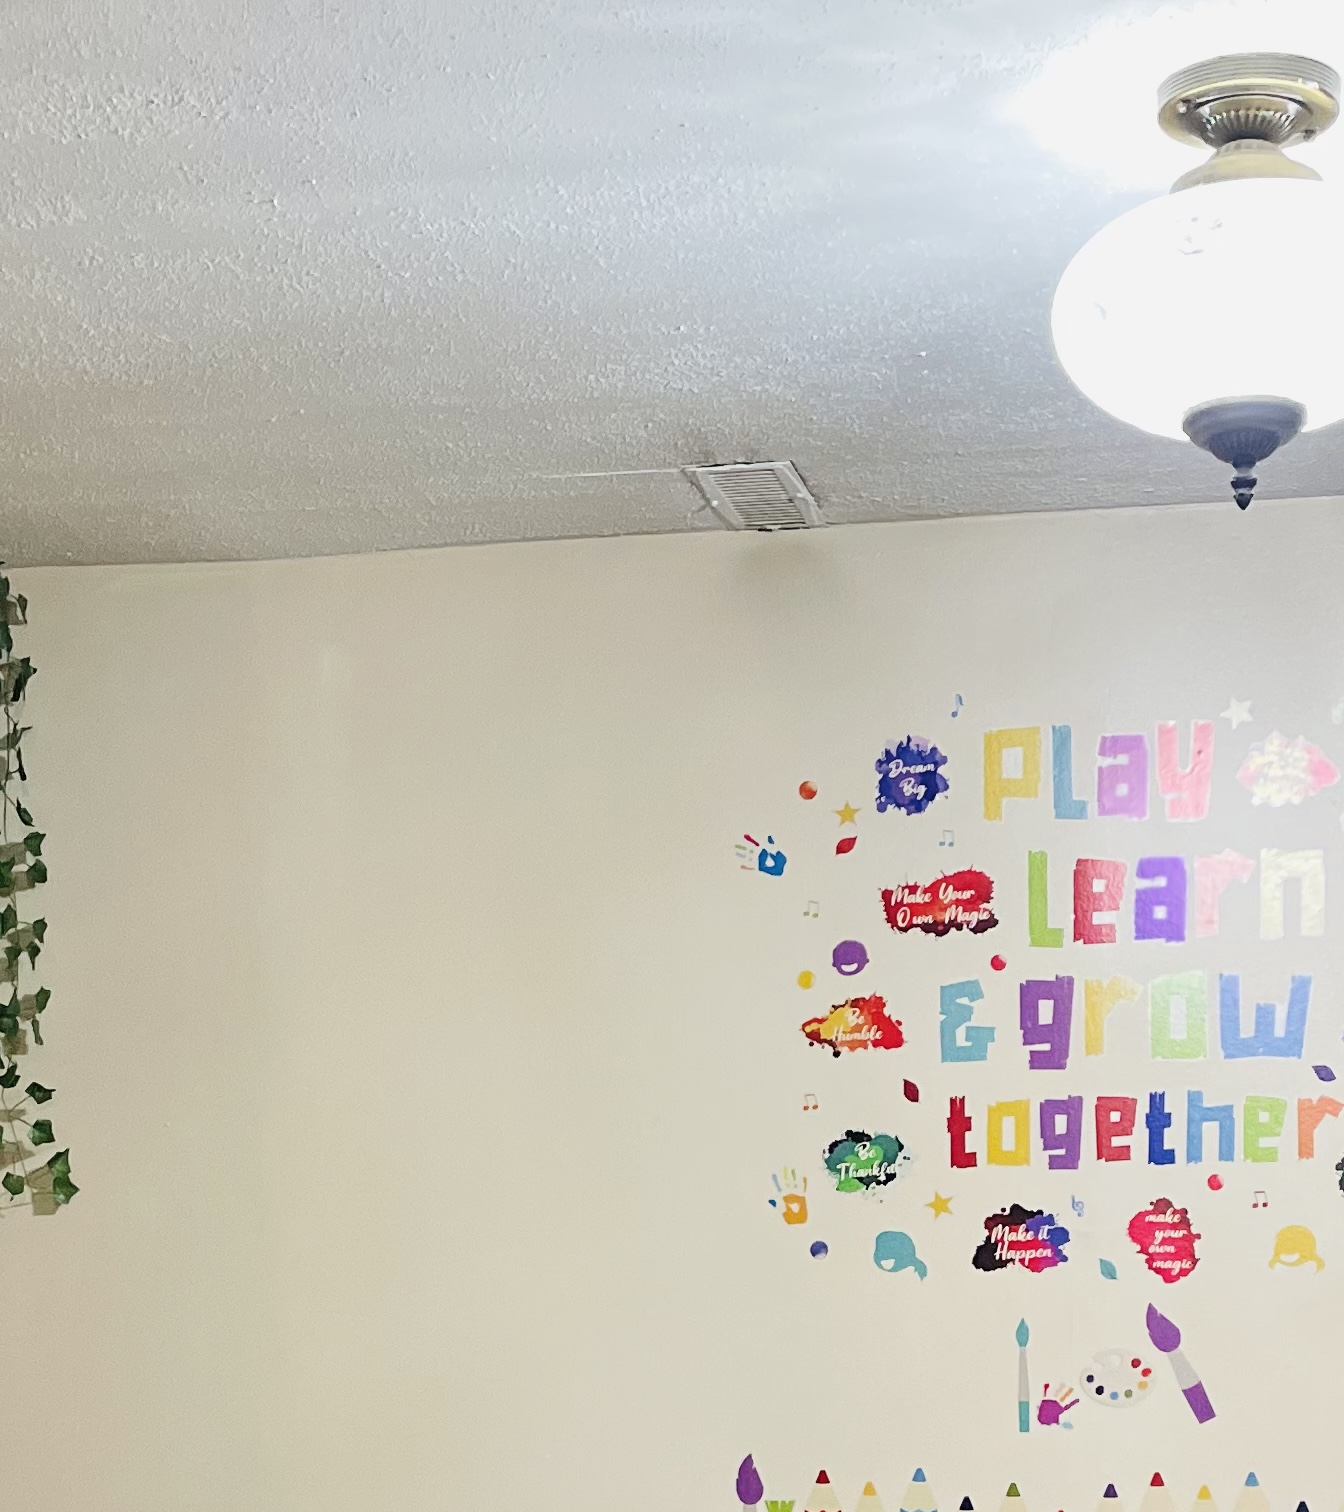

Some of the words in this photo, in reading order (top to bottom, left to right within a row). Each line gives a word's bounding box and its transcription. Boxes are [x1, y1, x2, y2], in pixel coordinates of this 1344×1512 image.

[888, 759, 935, 778] Dream
[899, 777, 927, 800] Big
[891, 886, 933, 906] Make
[938, 882, 976, 904] Your
[897, 906, 935, 927] Own
[945, 904, 991, 929] Magic
[843, 1006, 865, 1028] Be
[1019, 970, 1314, 1070] grow
[831, 1024, 884, 1043] Humble
[854, 1141, 876, 1161] Be
[836, 1159, 897, 1182] Thankfu
[1144, 1207, 1182, 1224] make
[991, 1223, 1035, 1243] Make
[1038, 1224, 1057, 1241] it
[1154, 1229, 1188, 1245] your
[994, 1241, 1054, 1267] Happen
[1148, 1244, 1177, 1254] own
[1152, 1259, 1194, 1276] magic
